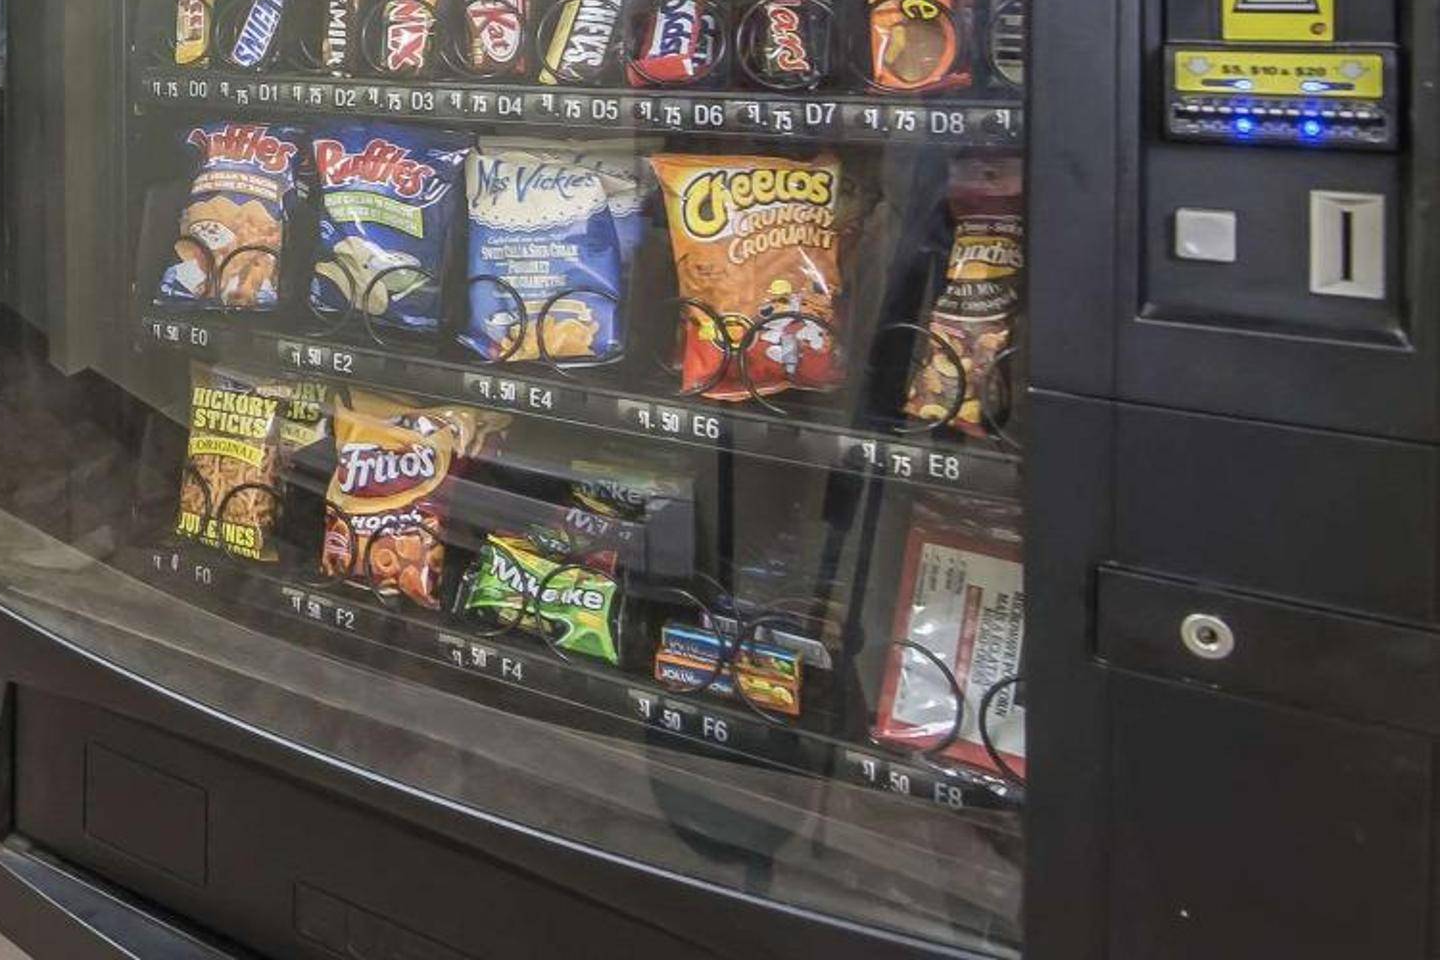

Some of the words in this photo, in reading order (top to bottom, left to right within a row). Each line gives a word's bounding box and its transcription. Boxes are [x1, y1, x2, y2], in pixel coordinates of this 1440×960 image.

[189, 81, 207, 98] D0
[259, 82, 279, 102] D1
[335, 87, 357, 108] D2
[411, 91, 435, 111] D3
[498, 94, 523, 115] D4
[592, 98, 619, 119] D5
[694, 104, 723, 125] D6
[805, 102, 837, 126] D7
[930, 111, 965, 134] D8
[313, 138, 437, 198] Ruffles
[516, 162, 593, 203] Vickie's
[682, 169, 834, 236] Cheetos
[731, 205, 836, 238] CRUNCHY
[728, 227, 835, 265] CROQUANT
[190, 328, 208, 346] E0
[333, 353, 353, 373] E2
[192, 387, 278, 419] HICKORY
[529, 389, 553, 410] E4
[193, 408, 268, 440] STICKS
[692, 416, 720, 439] E6
[340, 442, 436, 493] Fritos
[928, 453, 960, 481] E8
[335, 606, 356, 629] F2
[501, 658, 523, 680] F4
[703, 716, 728, 741] F6
